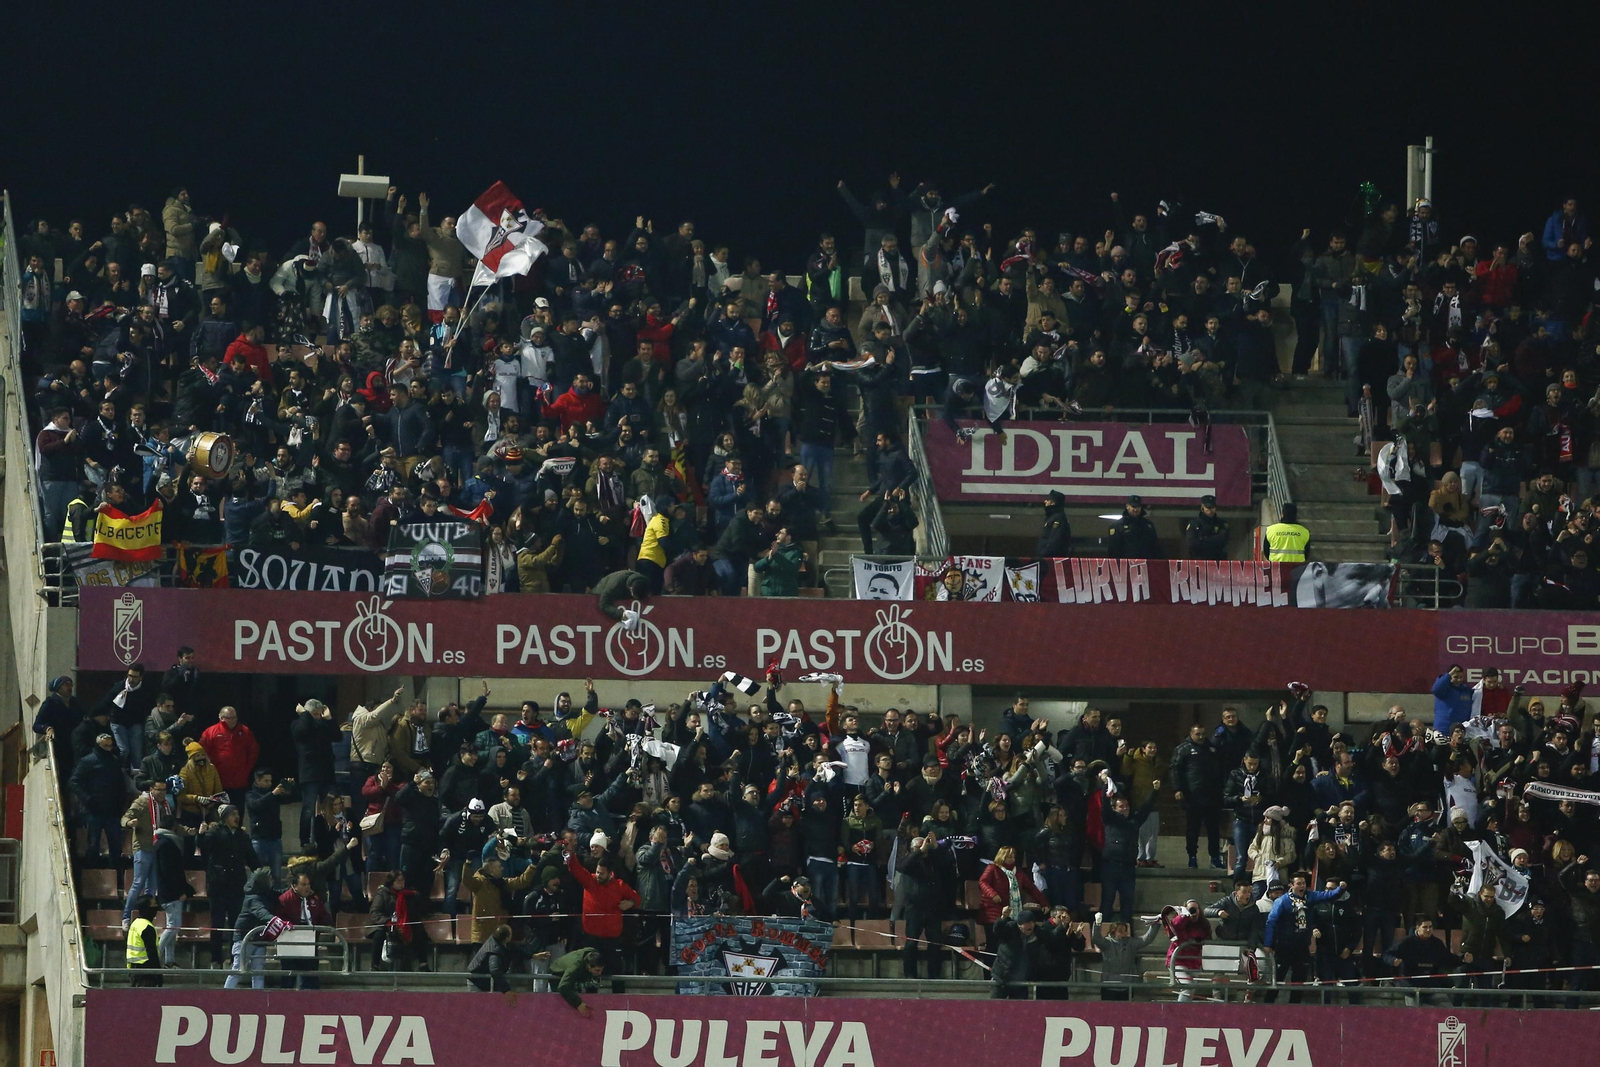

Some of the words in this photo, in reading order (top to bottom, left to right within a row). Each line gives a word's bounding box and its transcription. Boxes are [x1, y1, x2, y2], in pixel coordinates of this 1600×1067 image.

[961, 427, 1214, 480] IDEAL
[959, 557, 992, 570] FANS
[1168, 559, 1288, 607] ROMMEL
[1446, 635, 1564, 655] GRUPO
[1466, 668, 1600, 685] ETACIO
[155, 1006, 435, 1066] PULEVA
[600, 1009, 875, 1067] PULEVA
[1040, 1016, 1315, 1067] PULEVA
